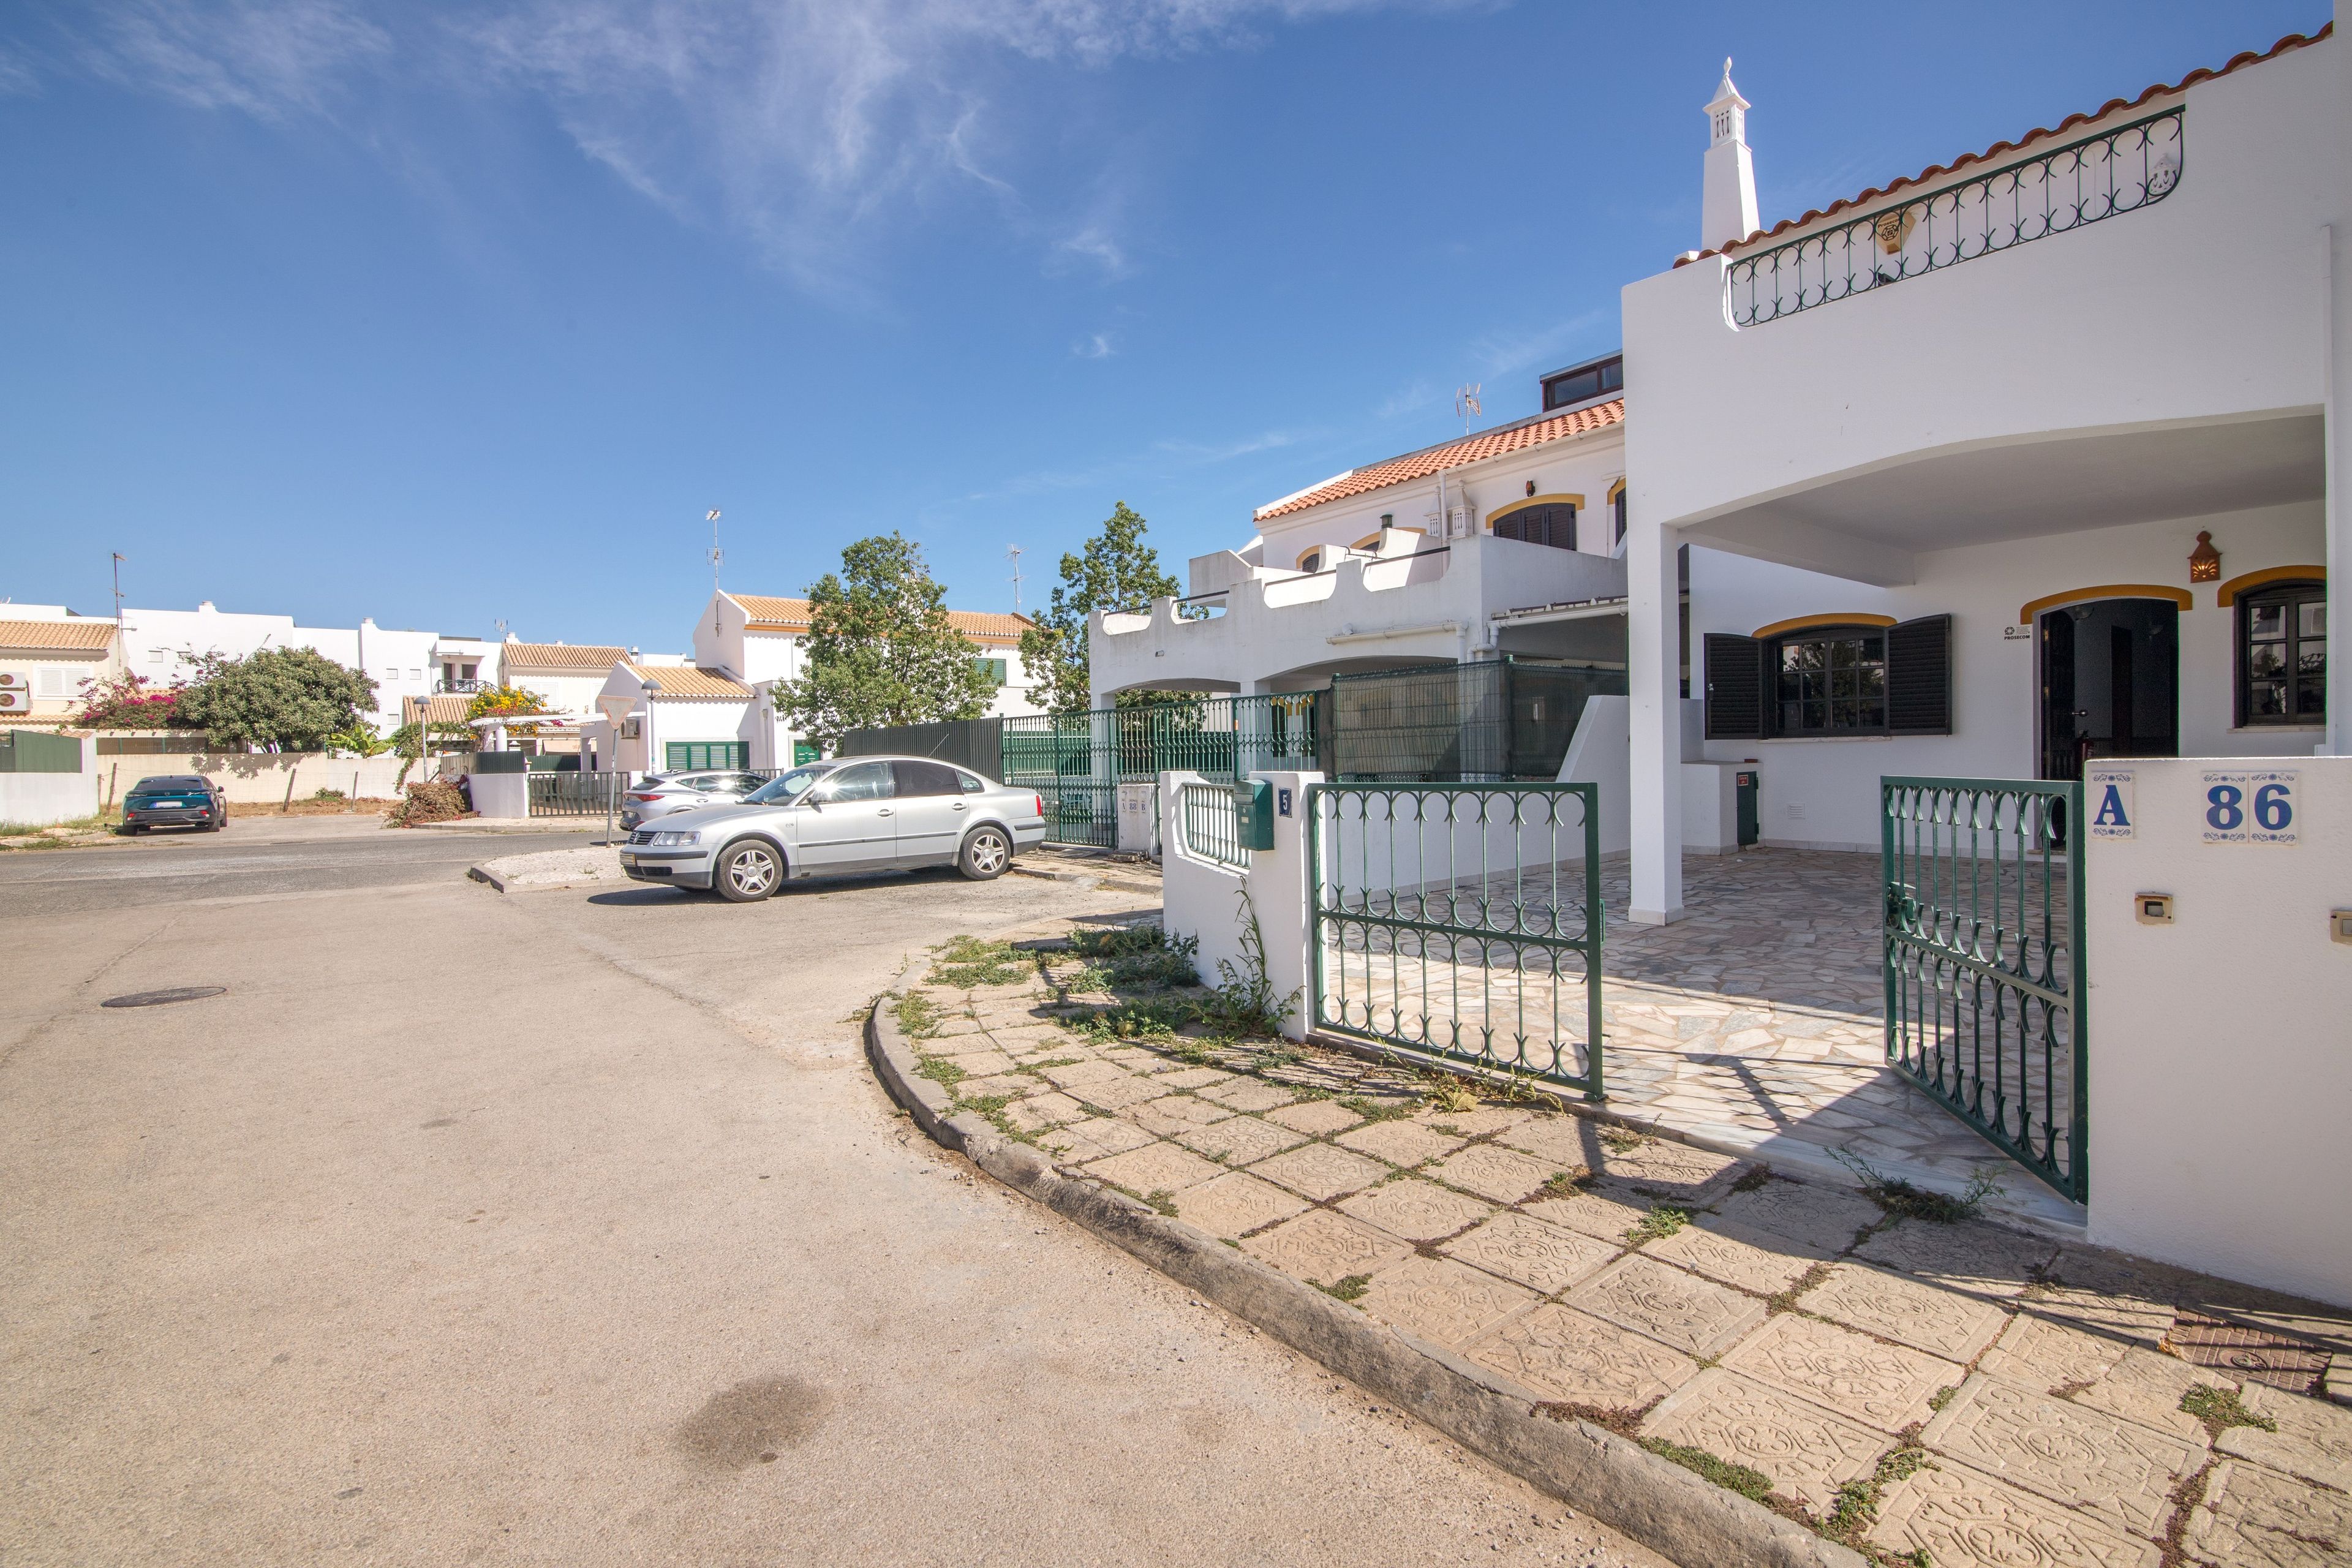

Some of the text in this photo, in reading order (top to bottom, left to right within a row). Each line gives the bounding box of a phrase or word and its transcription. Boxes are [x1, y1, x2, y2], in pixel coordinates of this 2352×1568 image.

[1877, 218, 1901, 228] Proseco
[1283, 794, 1287, 810] 5
[2094, 783, 2292, 831] A 86
